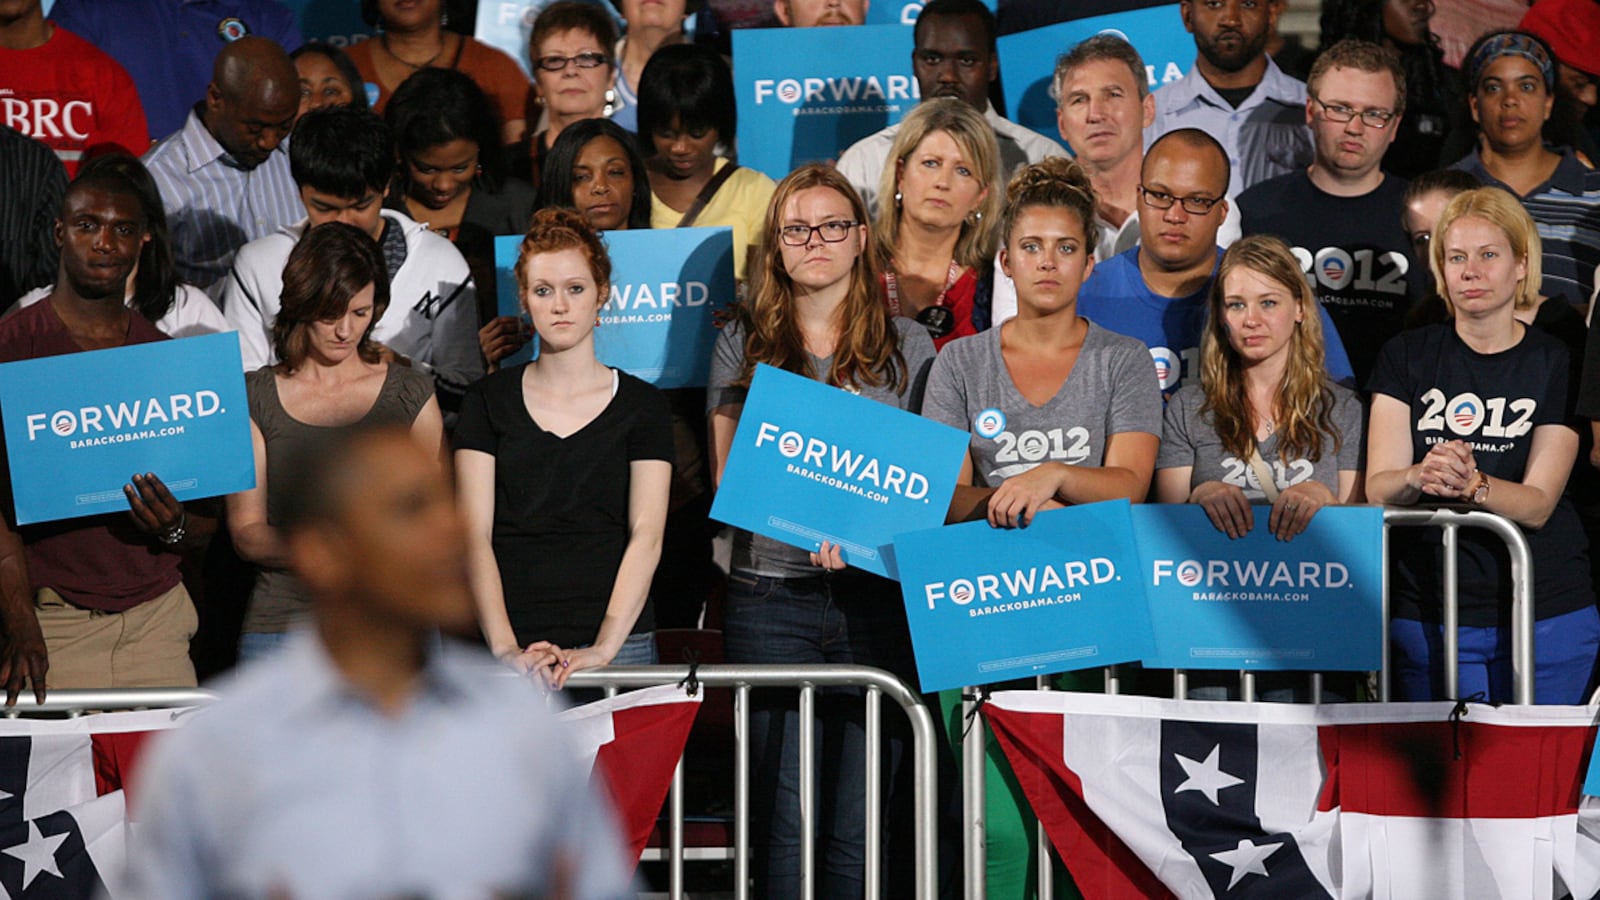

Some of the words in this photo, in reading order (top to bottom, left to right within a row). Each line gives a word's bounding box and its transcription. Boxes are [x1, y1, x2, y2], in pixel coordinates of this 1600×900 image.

[1, 98, 92, 140] BRC
[793, 104, 900, 115] BARACKOBAMA.COM
[604, 281, 714, 310] WARD.
[1320, 295, 1394, 308] ACKOBAMA.COM
[599, 313, 672, 325] KOBAMA.COM
[26, 390, 226, 441] FORWARD.
[1417, 388, 1537, 438] 2012
[70, 426, 185, 449] BARACKOBAMA.COM
[993, 426, 1091, 463] 2012
[754, 422, 930, 504] FORWARD.
[1221, 457, 1314, 491] 2012
[786, 463, 889, 505] BARACKOBAMA.COM
[924, 557, 1122, 610] FORWARD.
[1153, 560, 1353, 589] FORWARD.
[969, 592, 1081, 617] BARACKOBAMA.COM
[1193, 592, 1309, 601] BARACKOBAMA.COM
